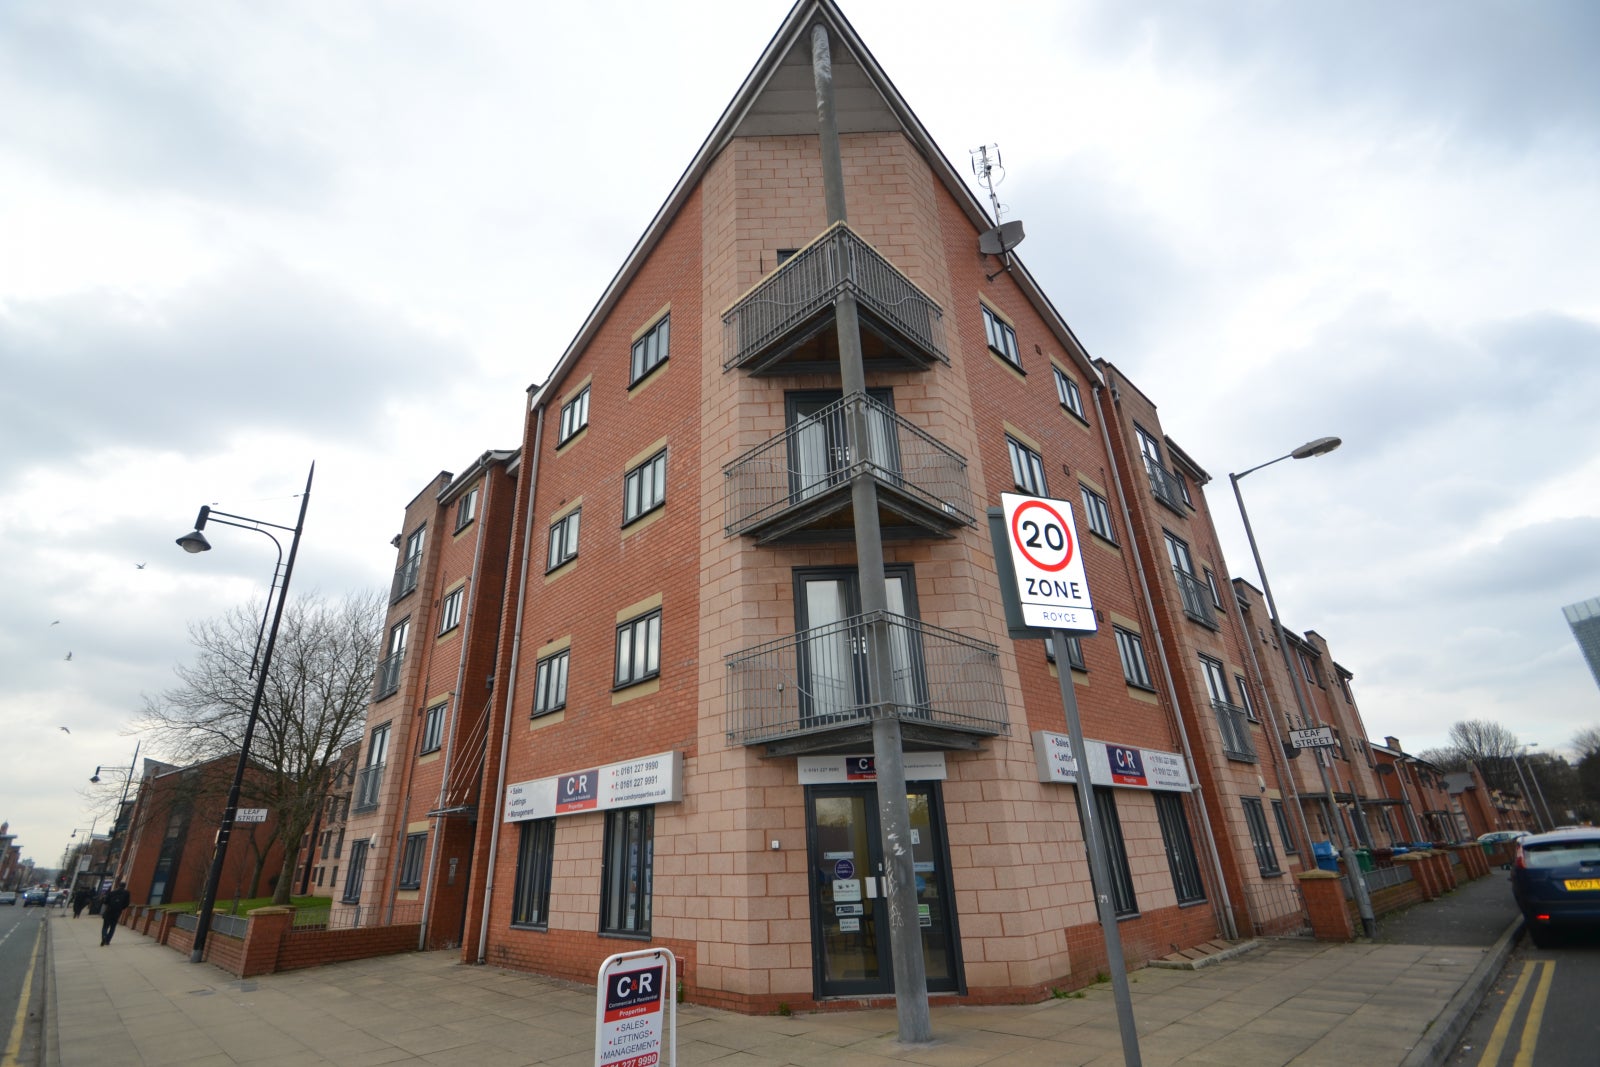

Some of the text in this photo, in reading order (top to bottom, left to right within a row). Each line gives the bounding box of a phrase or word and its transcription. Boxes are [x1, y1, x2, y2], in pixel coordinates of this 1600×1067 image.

[1022, 520, 1064, 551] 20
[1025, 577, 1081, 600] ZONE
[1043, 611, 1077, 623] ROYCE
[1299, 729, 1321, 738] LEAF
[1055, 737, 1069, 748] Sales
[1294, 736, 1330, 747] STREET
[1058, 751, 1073, 762] Lettin
[620, 766, 633, 776] 0161
[634, 763, 644, 773] 227
[645, 760, 659, 771] 9990
[566, 775, 587, 795] C&R
[620, 779, 633, 789] 0161
[633, 777, 644, 787] 227
[645, 775, 658, 785] 9991
[512, 787, 523, 795] Sales
[512, 799, 527, 807] Lettings
[511, 808, 534, 818] Management
[616, 972, 653, 998] C&R
[608, 999, 632, 1008] Commercial
[619, 1006, 647, 1017] Properties
[620, 1019, 645, 1032] SALES
[613, 1029, 650, 1046] LETTINGS
[603, 1039, 656, 1060] MANAGEMENT
[638, 1053, 657, 1067] 9990
